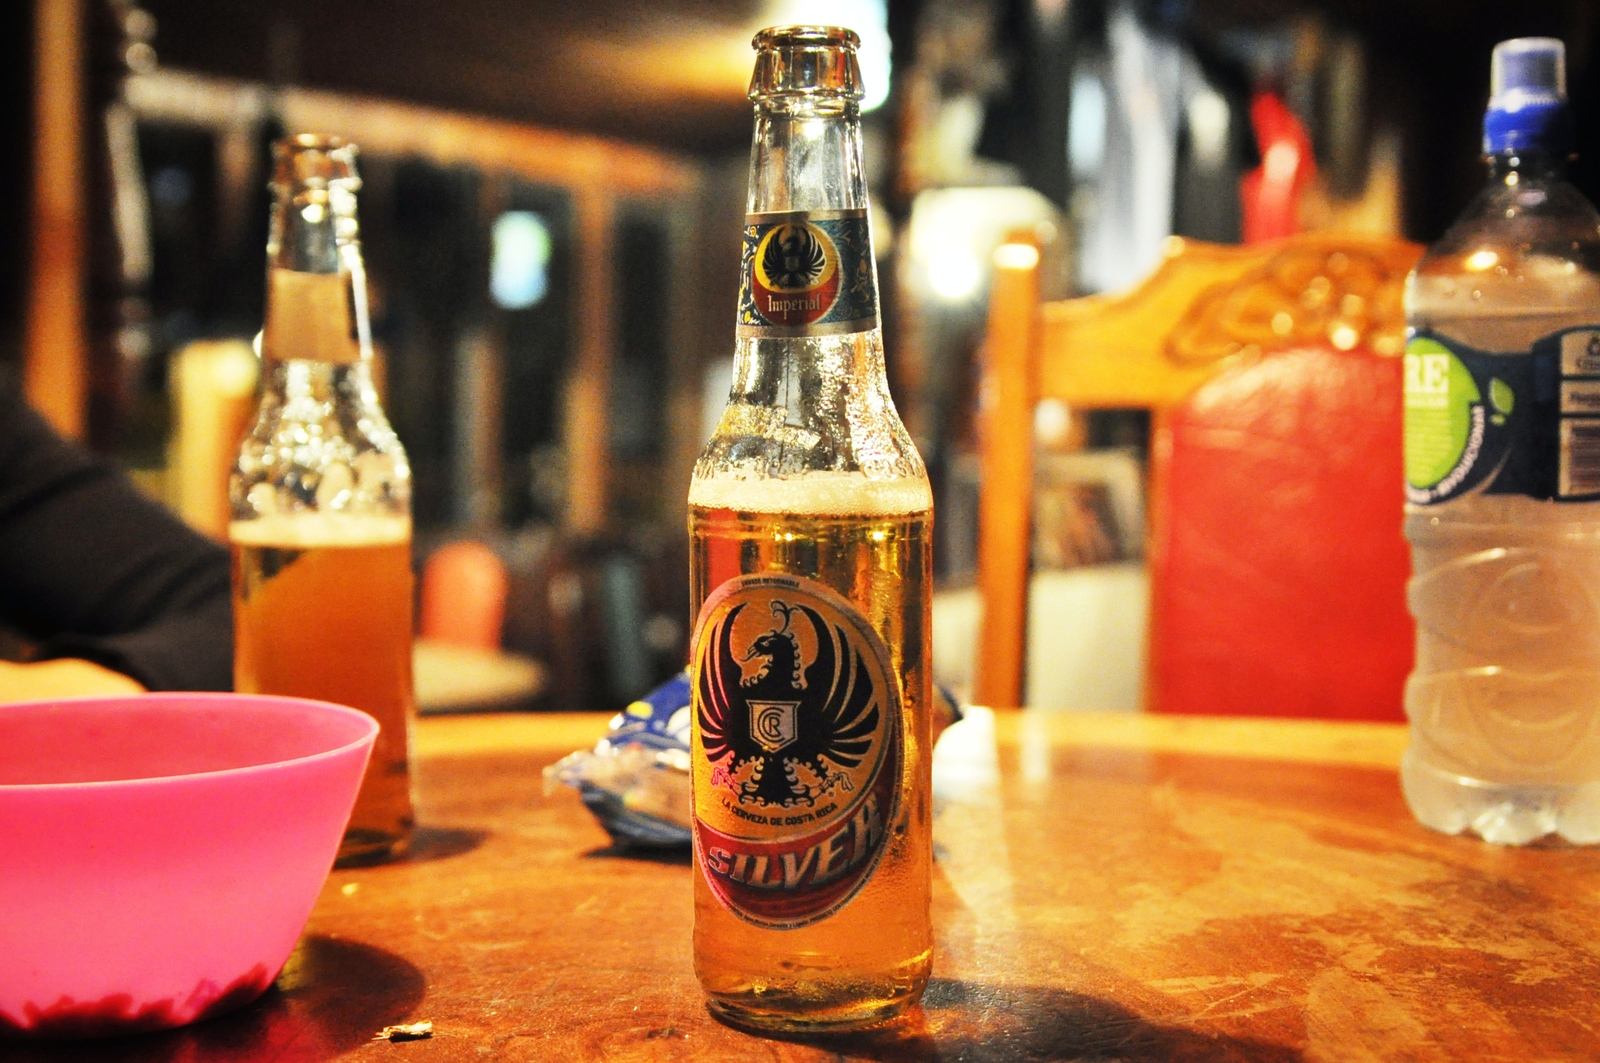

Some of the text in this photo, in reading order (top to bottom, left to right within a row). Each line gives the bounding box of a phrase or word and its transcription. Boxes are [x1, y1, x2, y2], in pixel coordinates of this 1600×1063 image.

[767, 293, 821, 320] Imperial
[721, 797, 837, 826] LA CERVEZA DE COSTA RICA
[708, 792, 881, 889] SILVER
